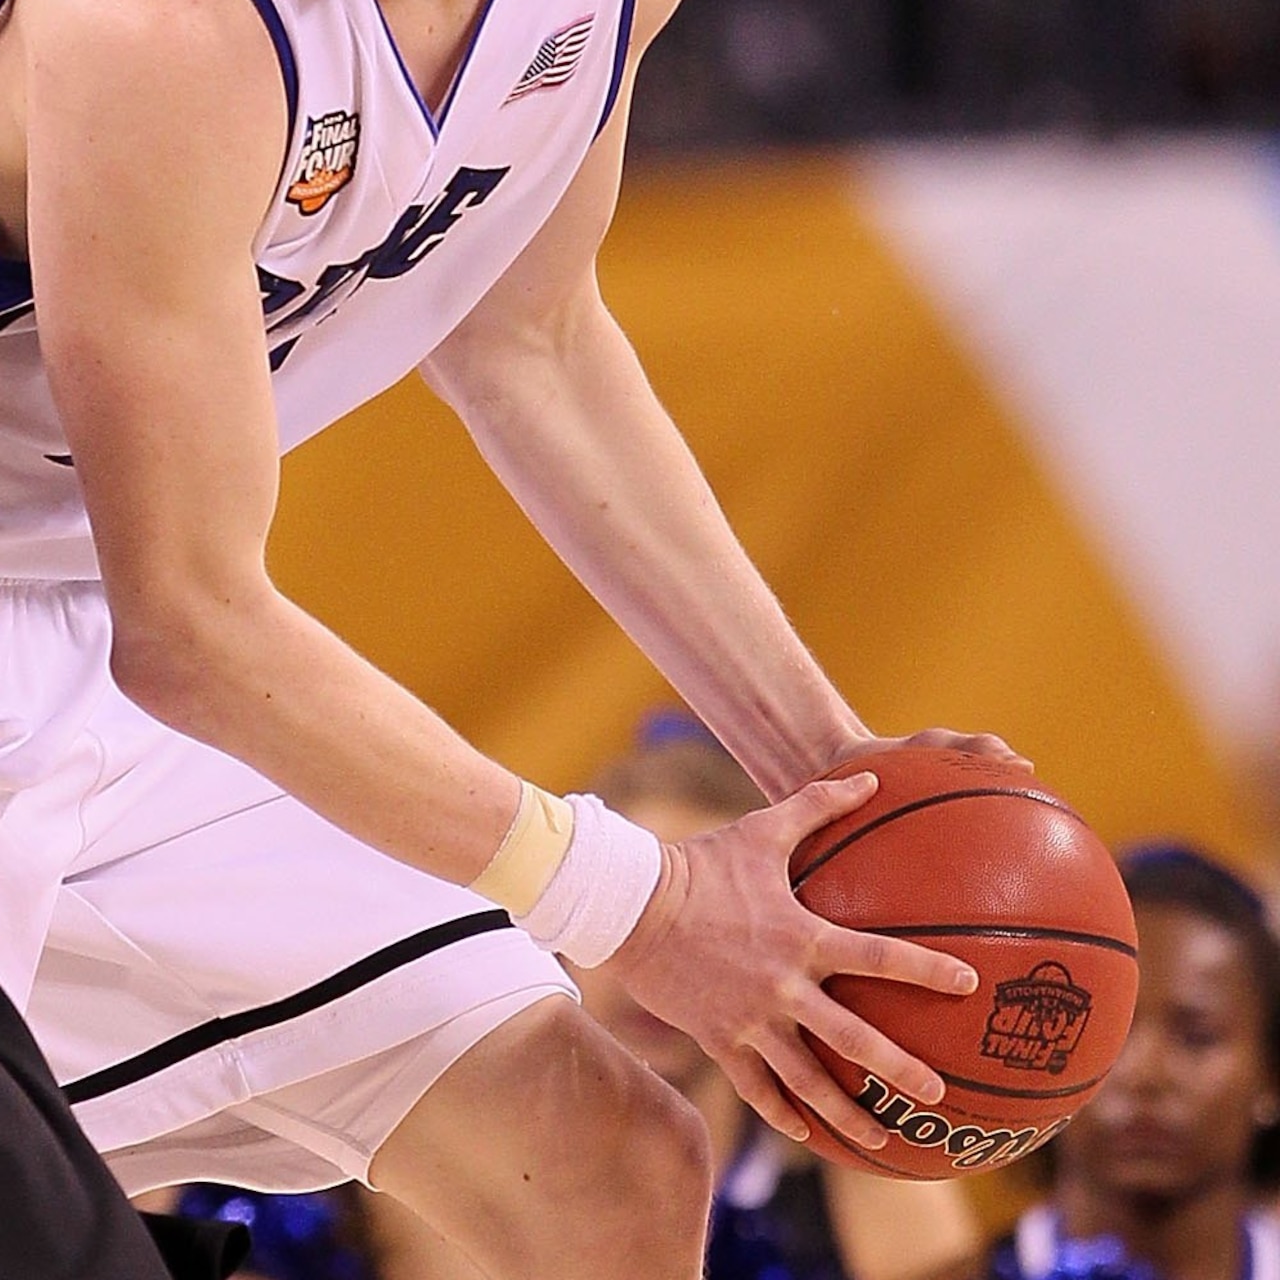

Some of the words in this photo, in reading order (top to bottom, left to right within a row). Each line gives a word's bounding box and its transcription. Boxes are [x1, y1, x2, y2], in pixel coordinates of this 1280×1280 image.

[311, 118, 358, 150] FINAL
[293, 140, 356, 184] FOUR
[991, 1005, 1088, 1052] FOUR
[986, 1034, 1056, 1068] FINAL
